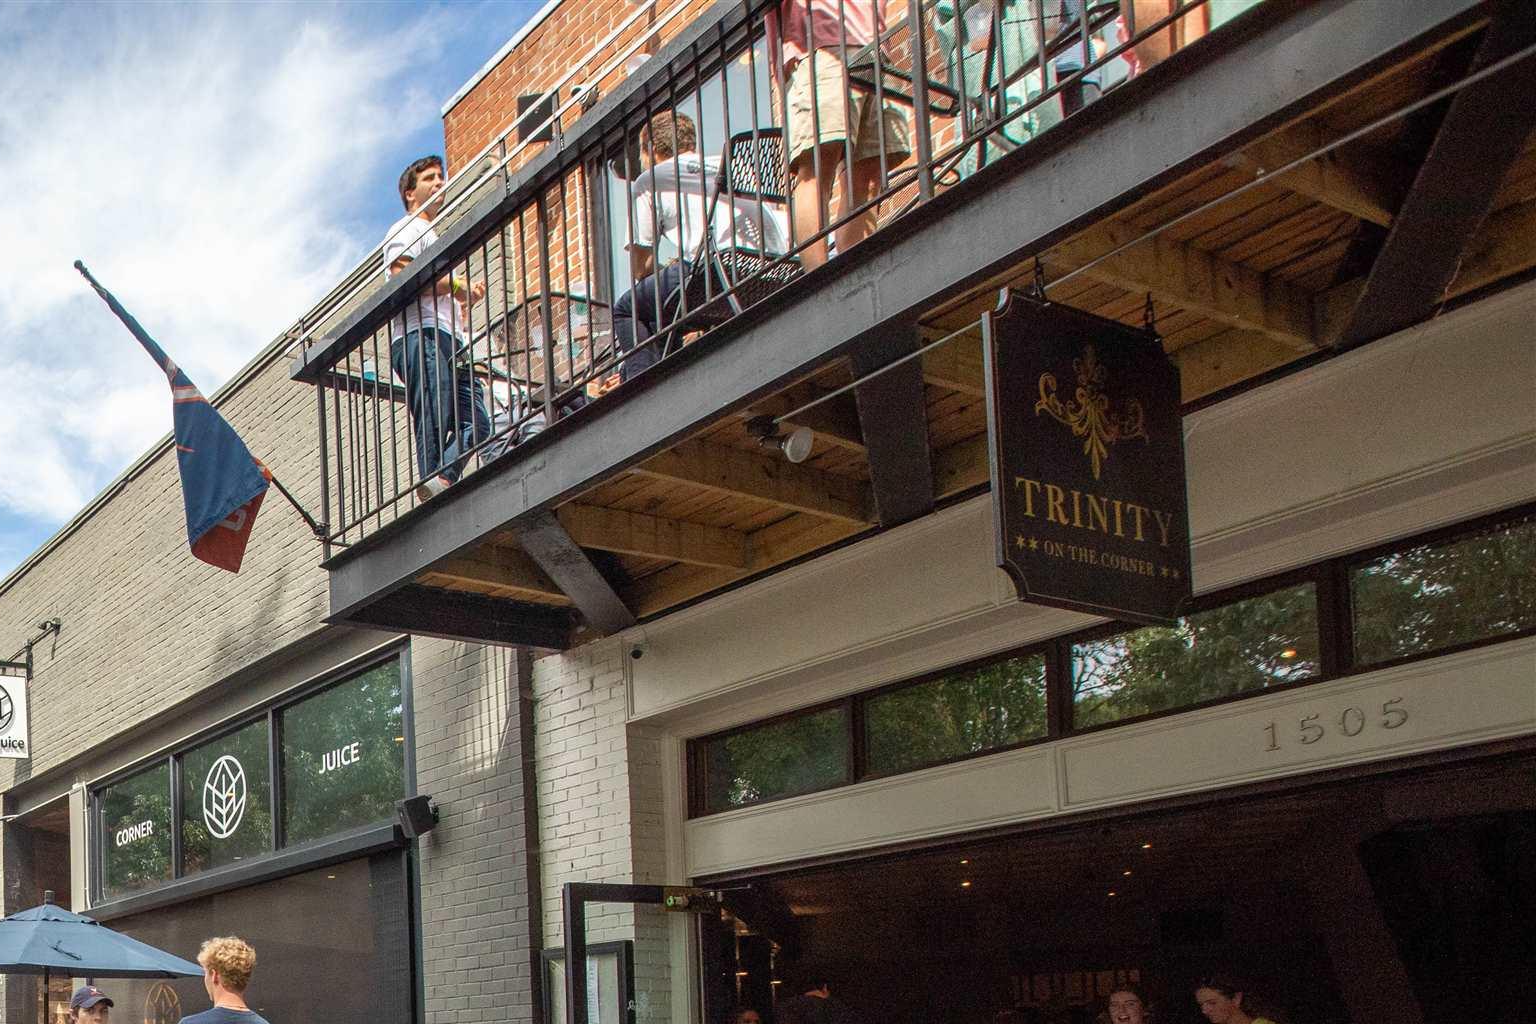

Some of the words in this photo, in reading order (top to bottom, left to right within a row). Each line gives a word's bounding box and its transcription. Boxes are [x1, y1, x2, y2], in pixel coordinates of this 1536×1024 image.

[1015, 477, 1173, 547] TRINITY
[1044, 540, 1064, 558] ON
[1067, 545, 1097, 565] THE
[1101, 553, 1155, 576] CORNER
[1263, 697, 1409, 752] 1505
[116, 820, 153, 847] CORNER
[318, 742, 360, 774] JUICE
